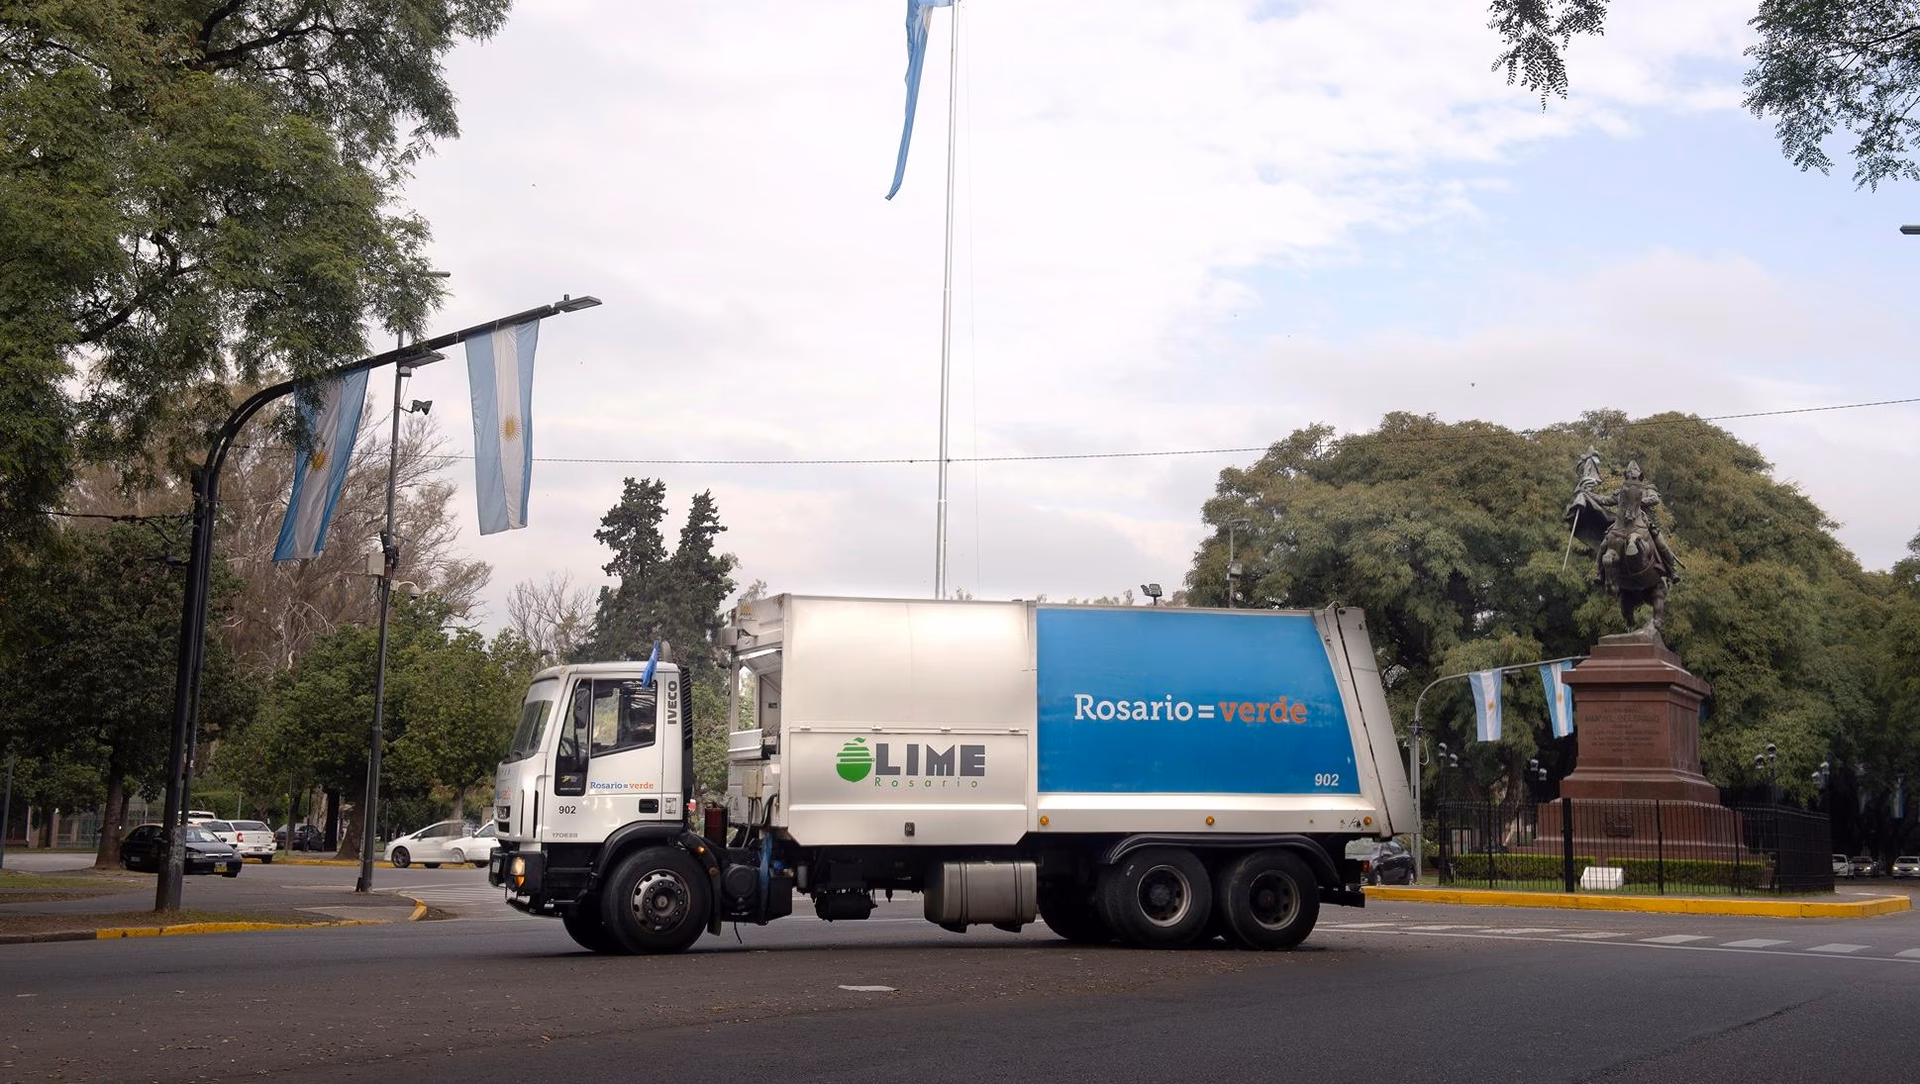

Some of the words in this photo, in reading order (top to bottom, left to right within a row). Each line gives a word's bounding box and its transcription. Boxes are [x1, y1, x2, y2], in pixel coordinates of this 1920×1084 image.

[667, 680, 678, 725] IVECO
[875, 743, 985, 777] LIME
[874, 776, 979, 788] Rosario
[1314, 773, 1340, 787] 902
[558, 805, 577, 815] 902
